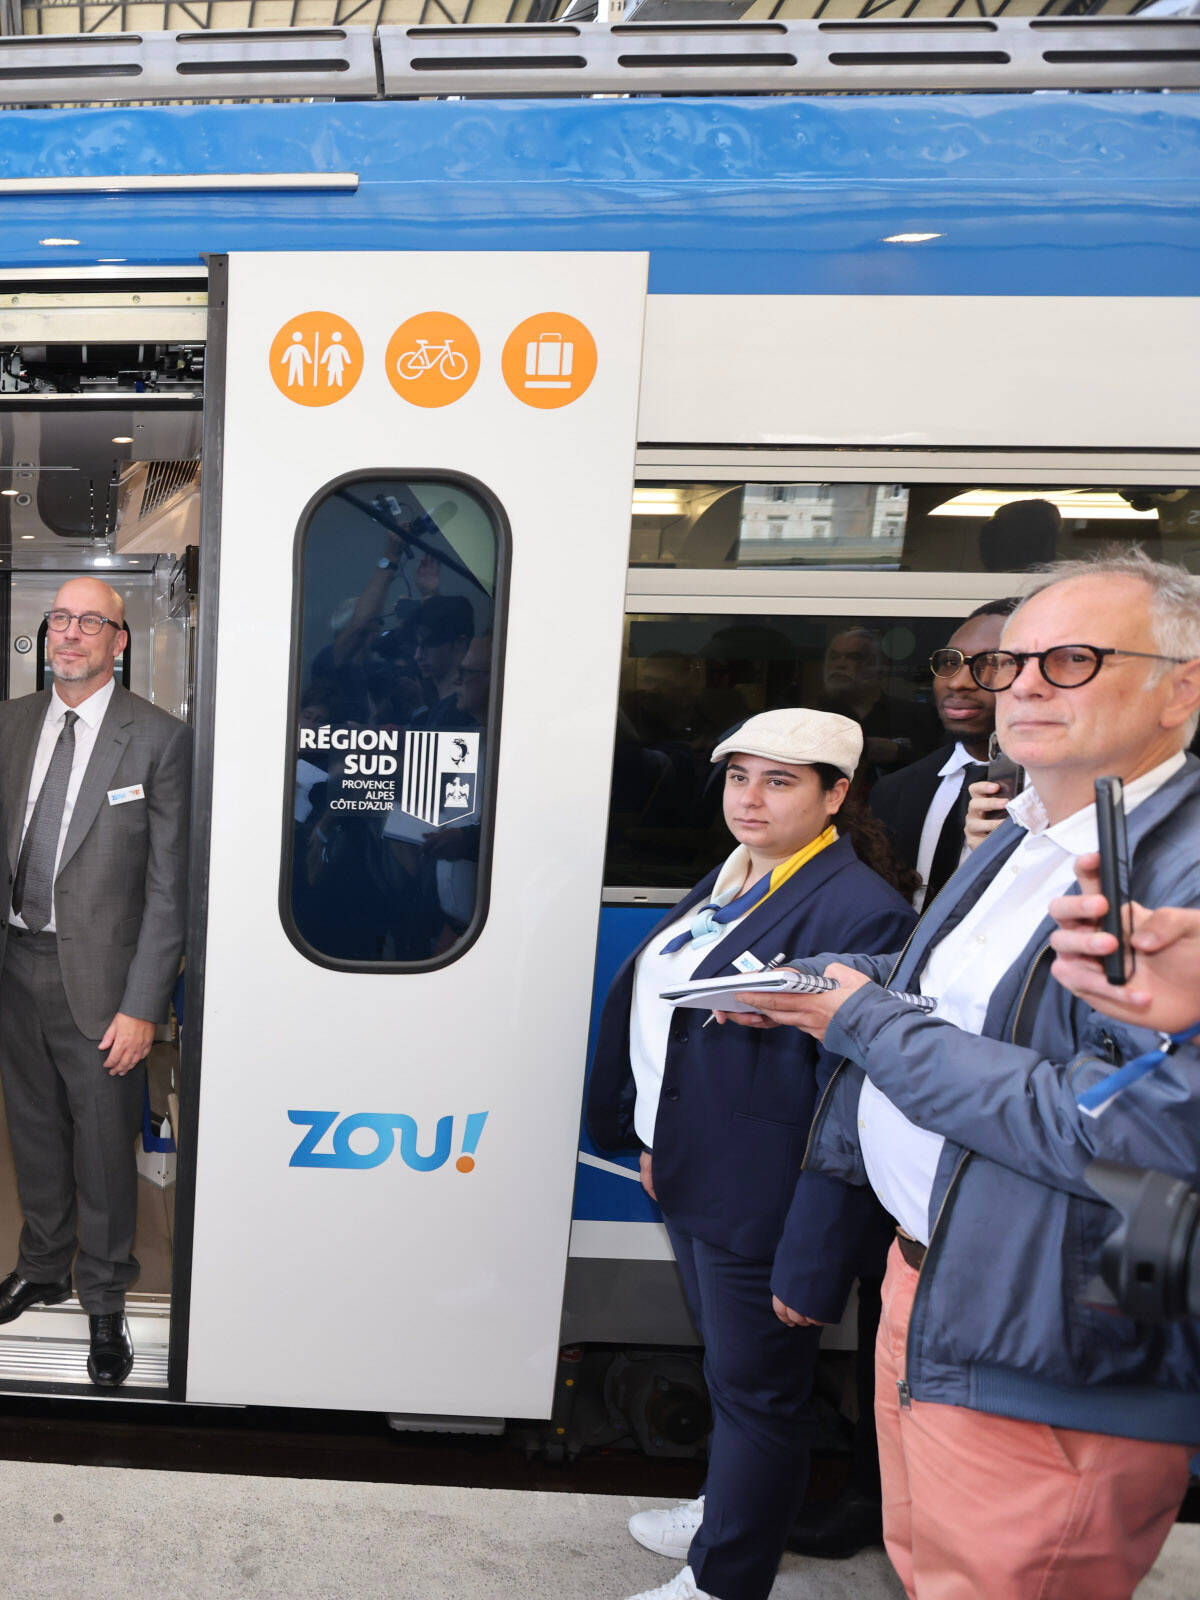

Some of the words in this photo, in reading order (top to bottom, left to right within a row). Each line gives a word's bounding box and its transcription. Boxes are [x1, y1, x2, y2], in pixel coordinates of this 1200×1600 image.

[300, 725, 398, 751] RÉGION
[343, 754, 398, 776] SUD
[341, 779, 396, 790] PROVENCE
[329, 798, 357, 810] CÔTE
[358, 800, 395, 811] D'AZUR
[365, 791, 395, 801] ALPES
[287, 1110, 490, 1174] ZOU!
